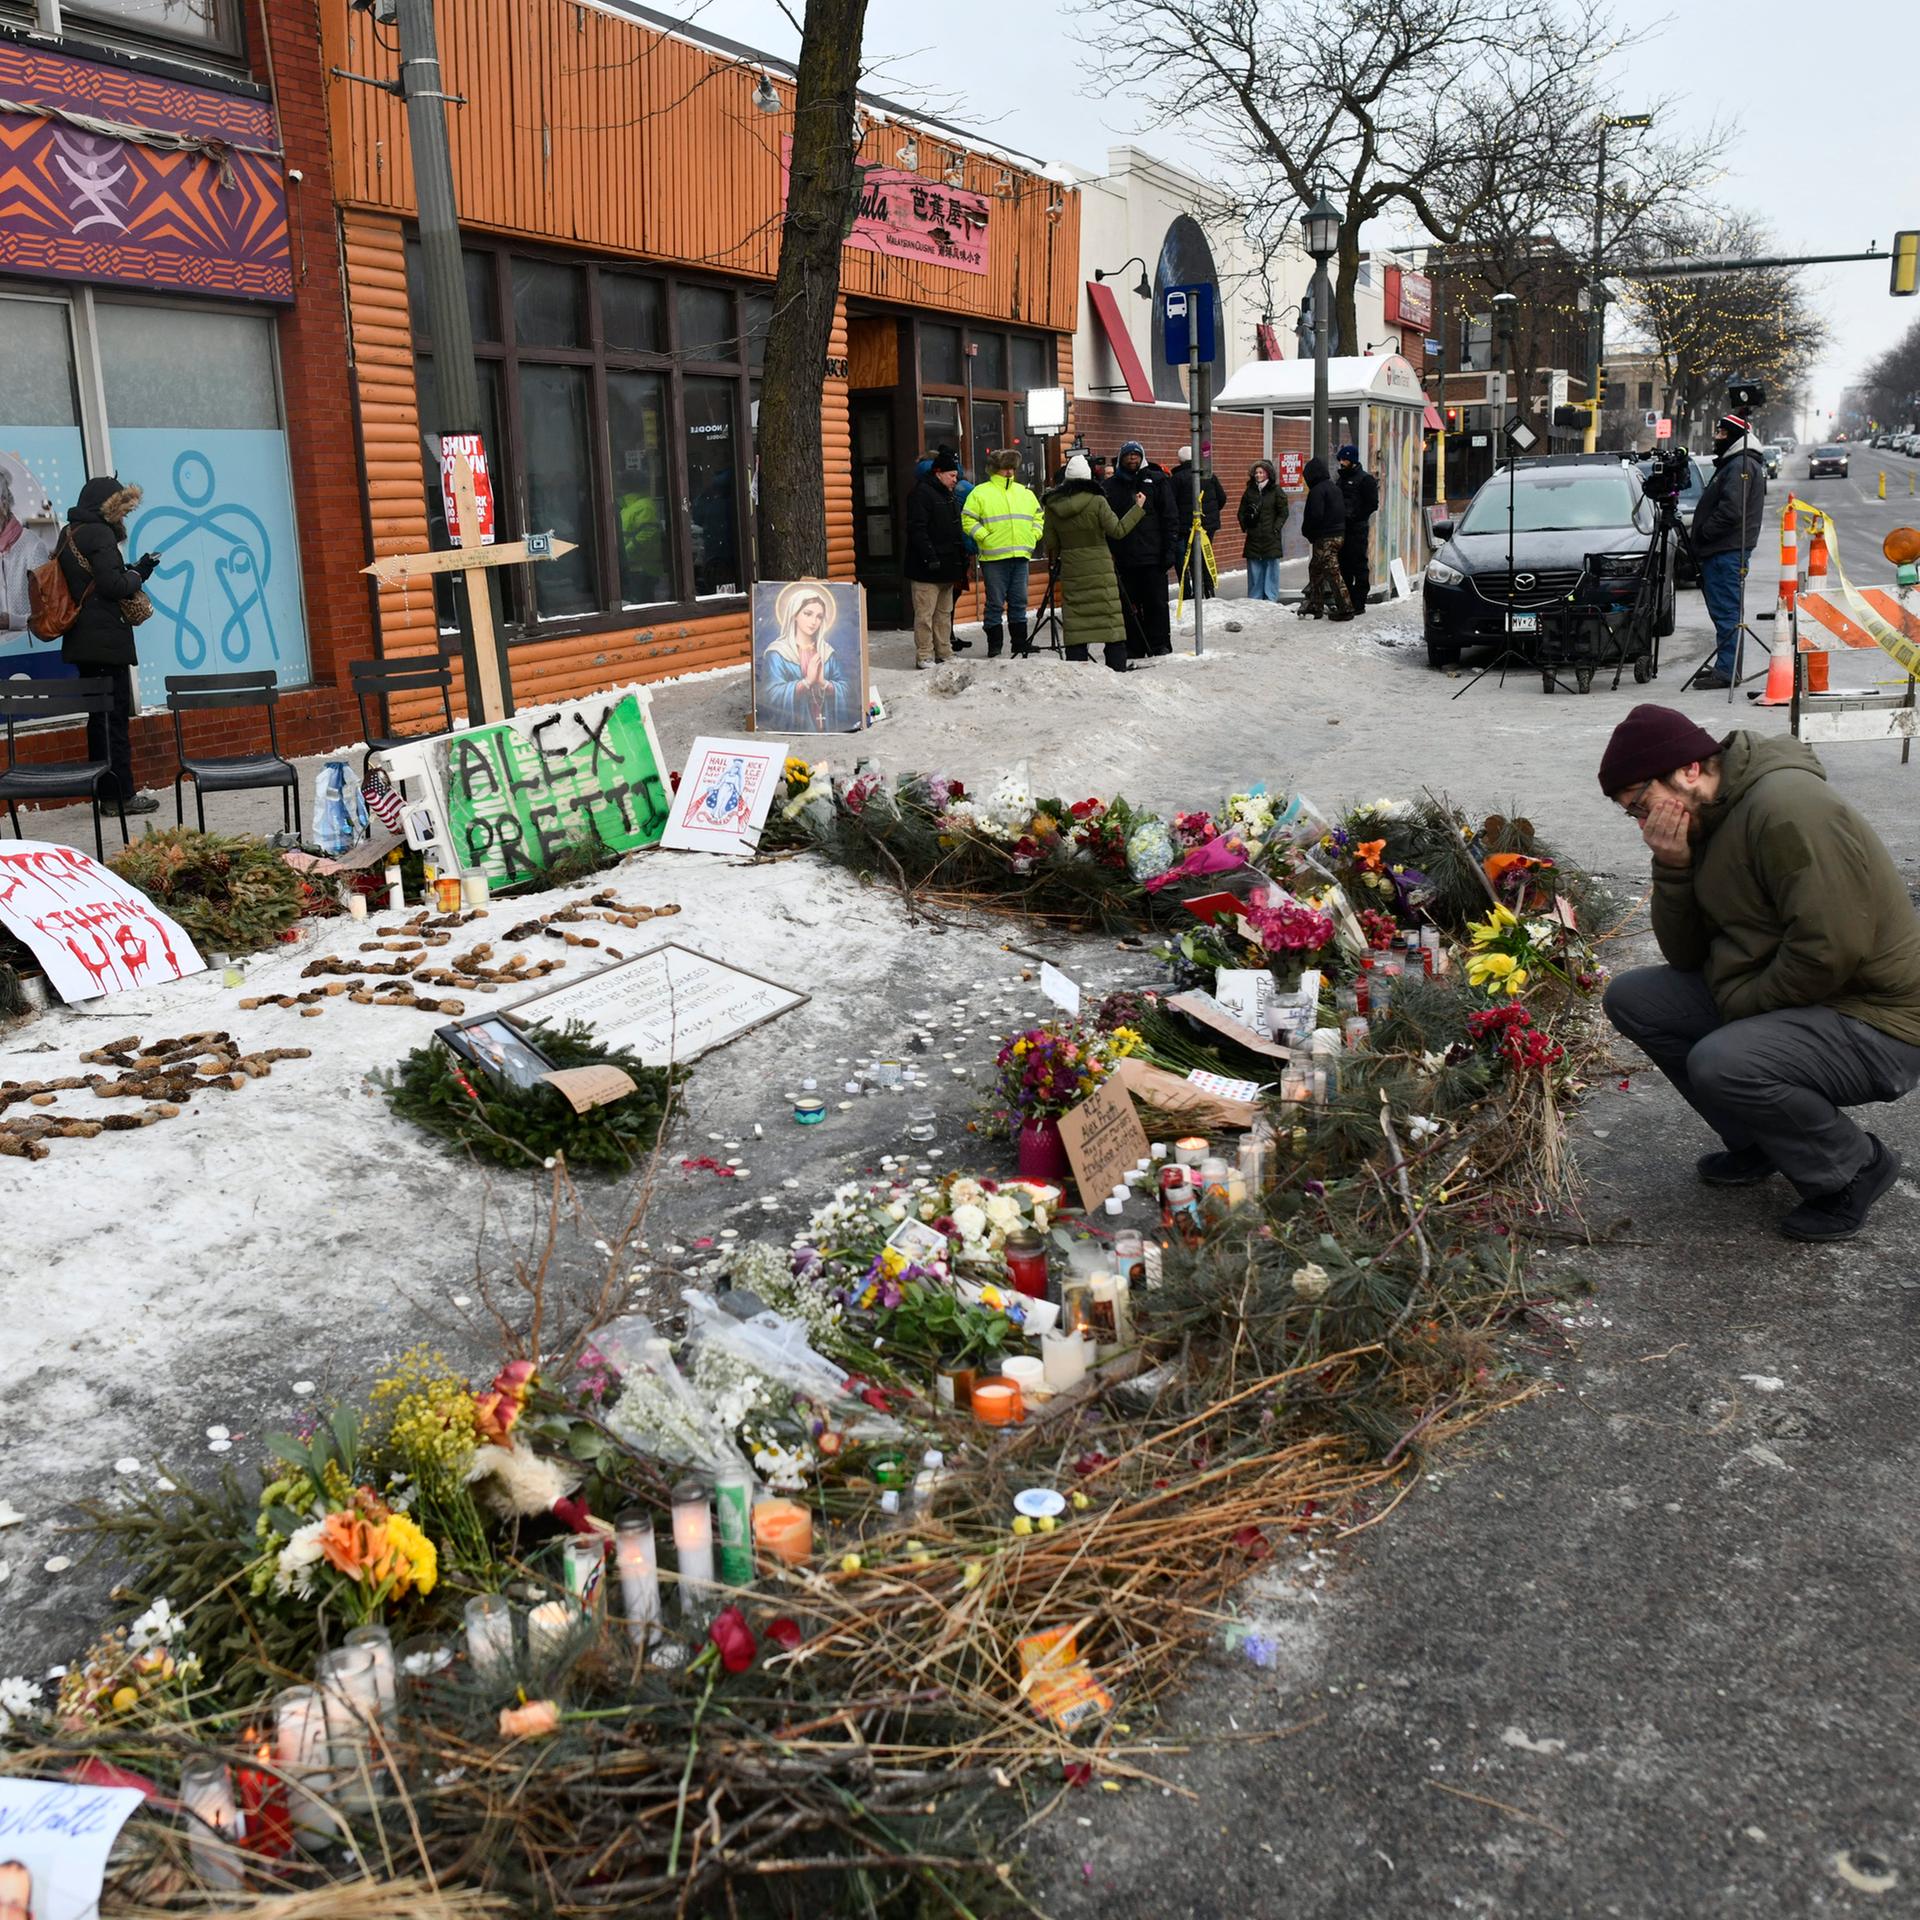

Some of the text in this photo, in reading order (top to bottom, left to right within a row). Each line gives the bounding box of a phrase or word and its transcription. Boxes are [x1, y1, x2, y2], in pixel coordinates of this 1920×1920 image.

[850, 182, 888, 222] ula
[442, 436, 479, 455] SHUT
[458, 706, 625, 801] ALEX
[709, 757, 728, 766] HAIL
[465, 774, 672, 884] PRETTI
[544, 990, 593, 1012] STRONG
[595, 960, 664, 992] COURAGEOUS
[623, 976, 660, 995] AFRAID
[1082, 1092, 1102, 1118] RIP
[1081, 1121, 1099, 1141] Alex
